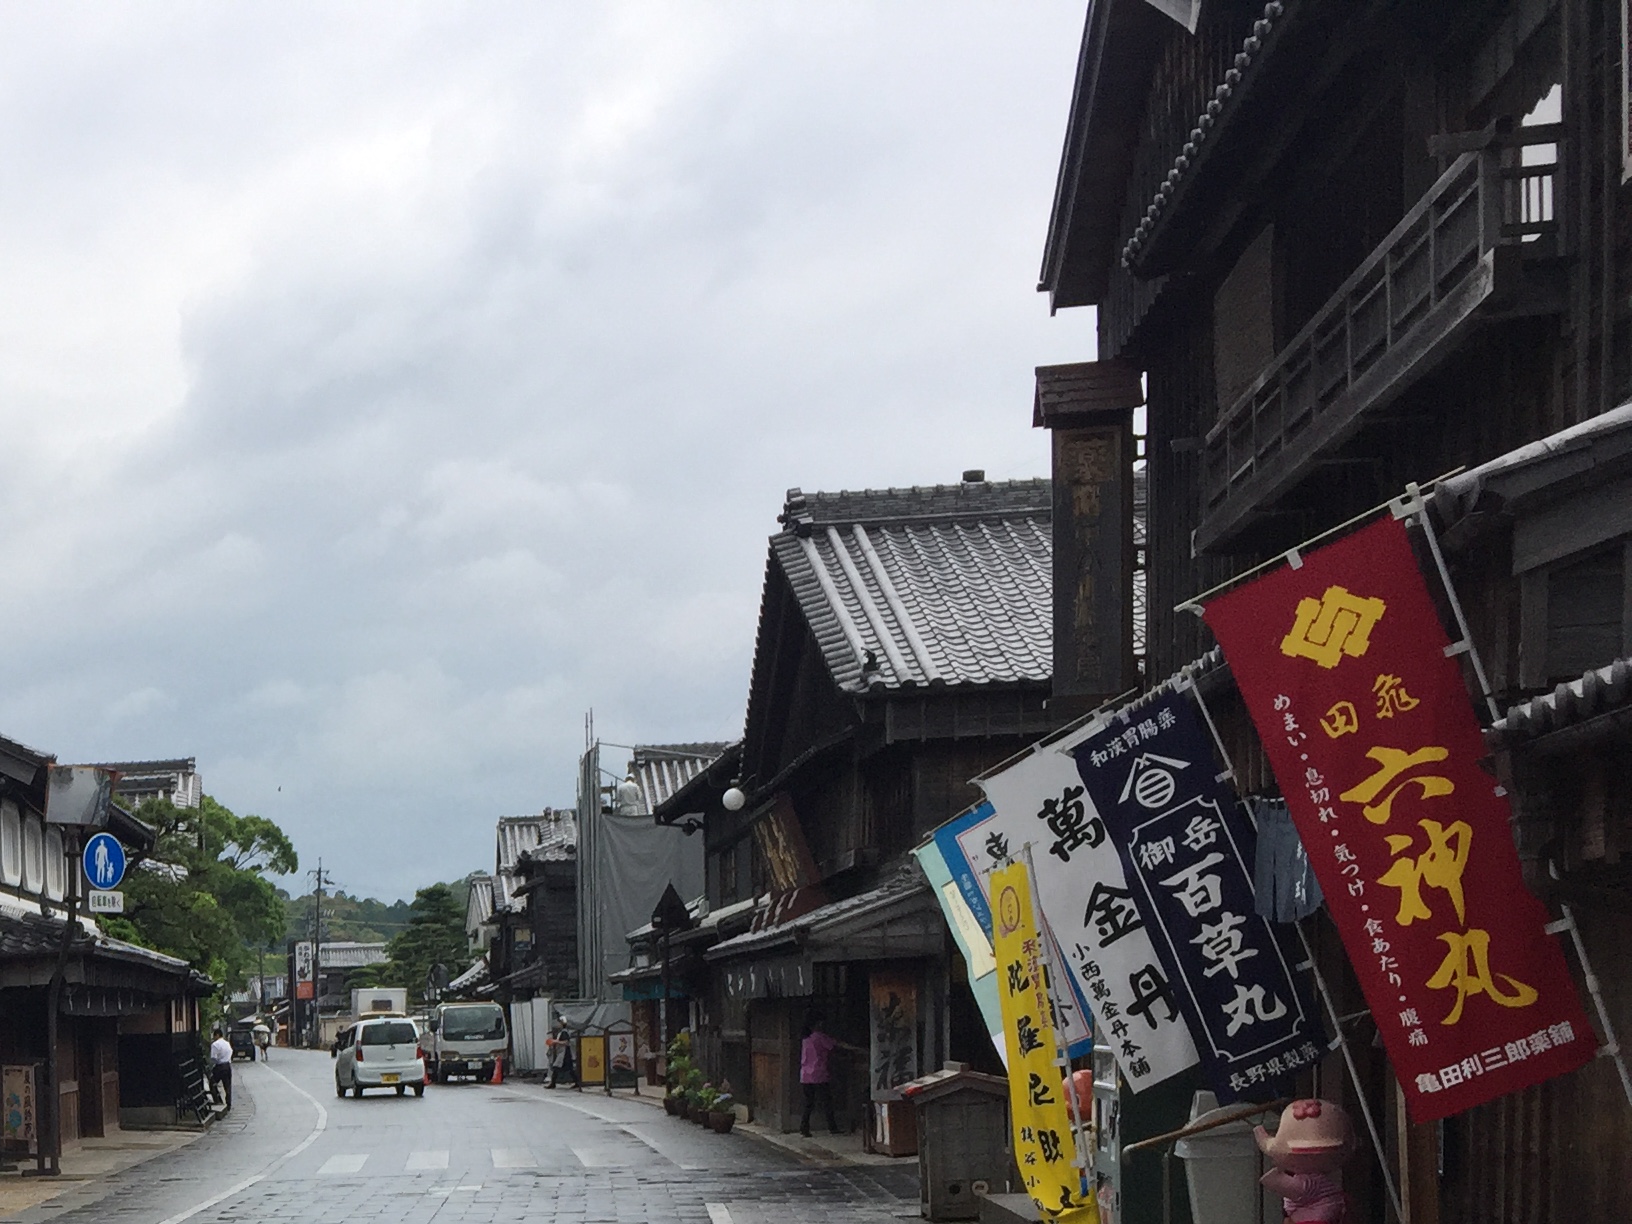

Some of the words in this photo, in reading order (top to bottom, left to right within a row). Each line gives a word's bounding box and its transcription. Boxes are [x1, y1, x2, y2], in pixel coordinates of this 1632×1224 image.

[1090, 707, 1176, 768] 和漢胃腸薬
[1038, 785, 1179, 1030] 萬金丹
[1159, 853, 1287, 1037] 百草丸
[1340, 746, 1538, 1025] 六神丸
[1072, 942, 1151, 1079] 小西萬金丹本舗
[1230, 1041, 1320, 1092] 長野県製薬
[1415, 1020, 1576, 1094] 亀田利三郎薬舗
